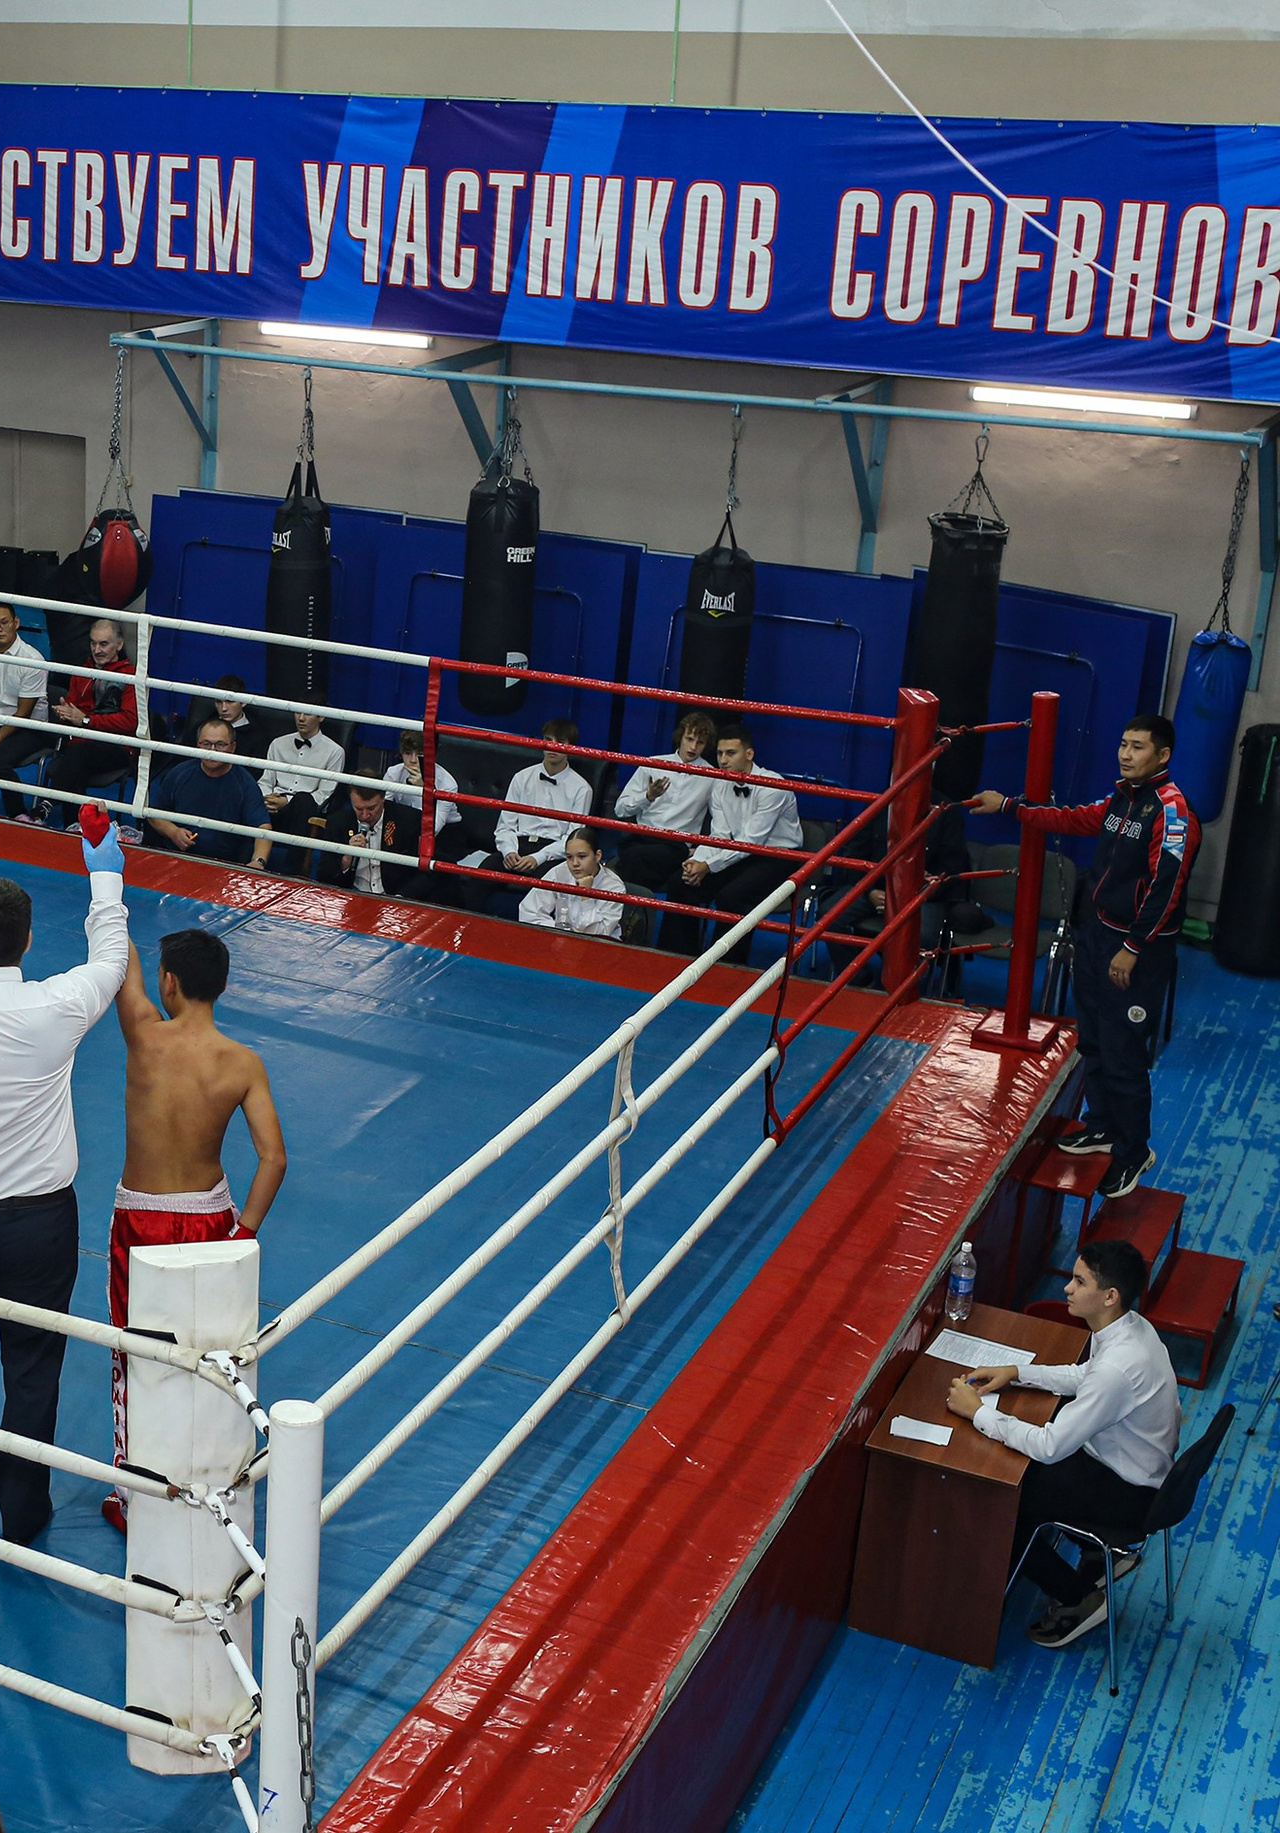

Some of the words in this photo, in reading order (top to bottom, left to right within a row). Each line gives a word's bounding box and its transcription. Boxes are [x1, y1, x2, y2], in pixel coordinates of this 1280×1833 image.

[299, 160, 780, 314] УЧАСТНИКОВ
[828, 187, 1280, 347] СОРЕВНОВ
[507, 554, 533, 563] HILL
[700, 588, 736, 613] EVERLAST
